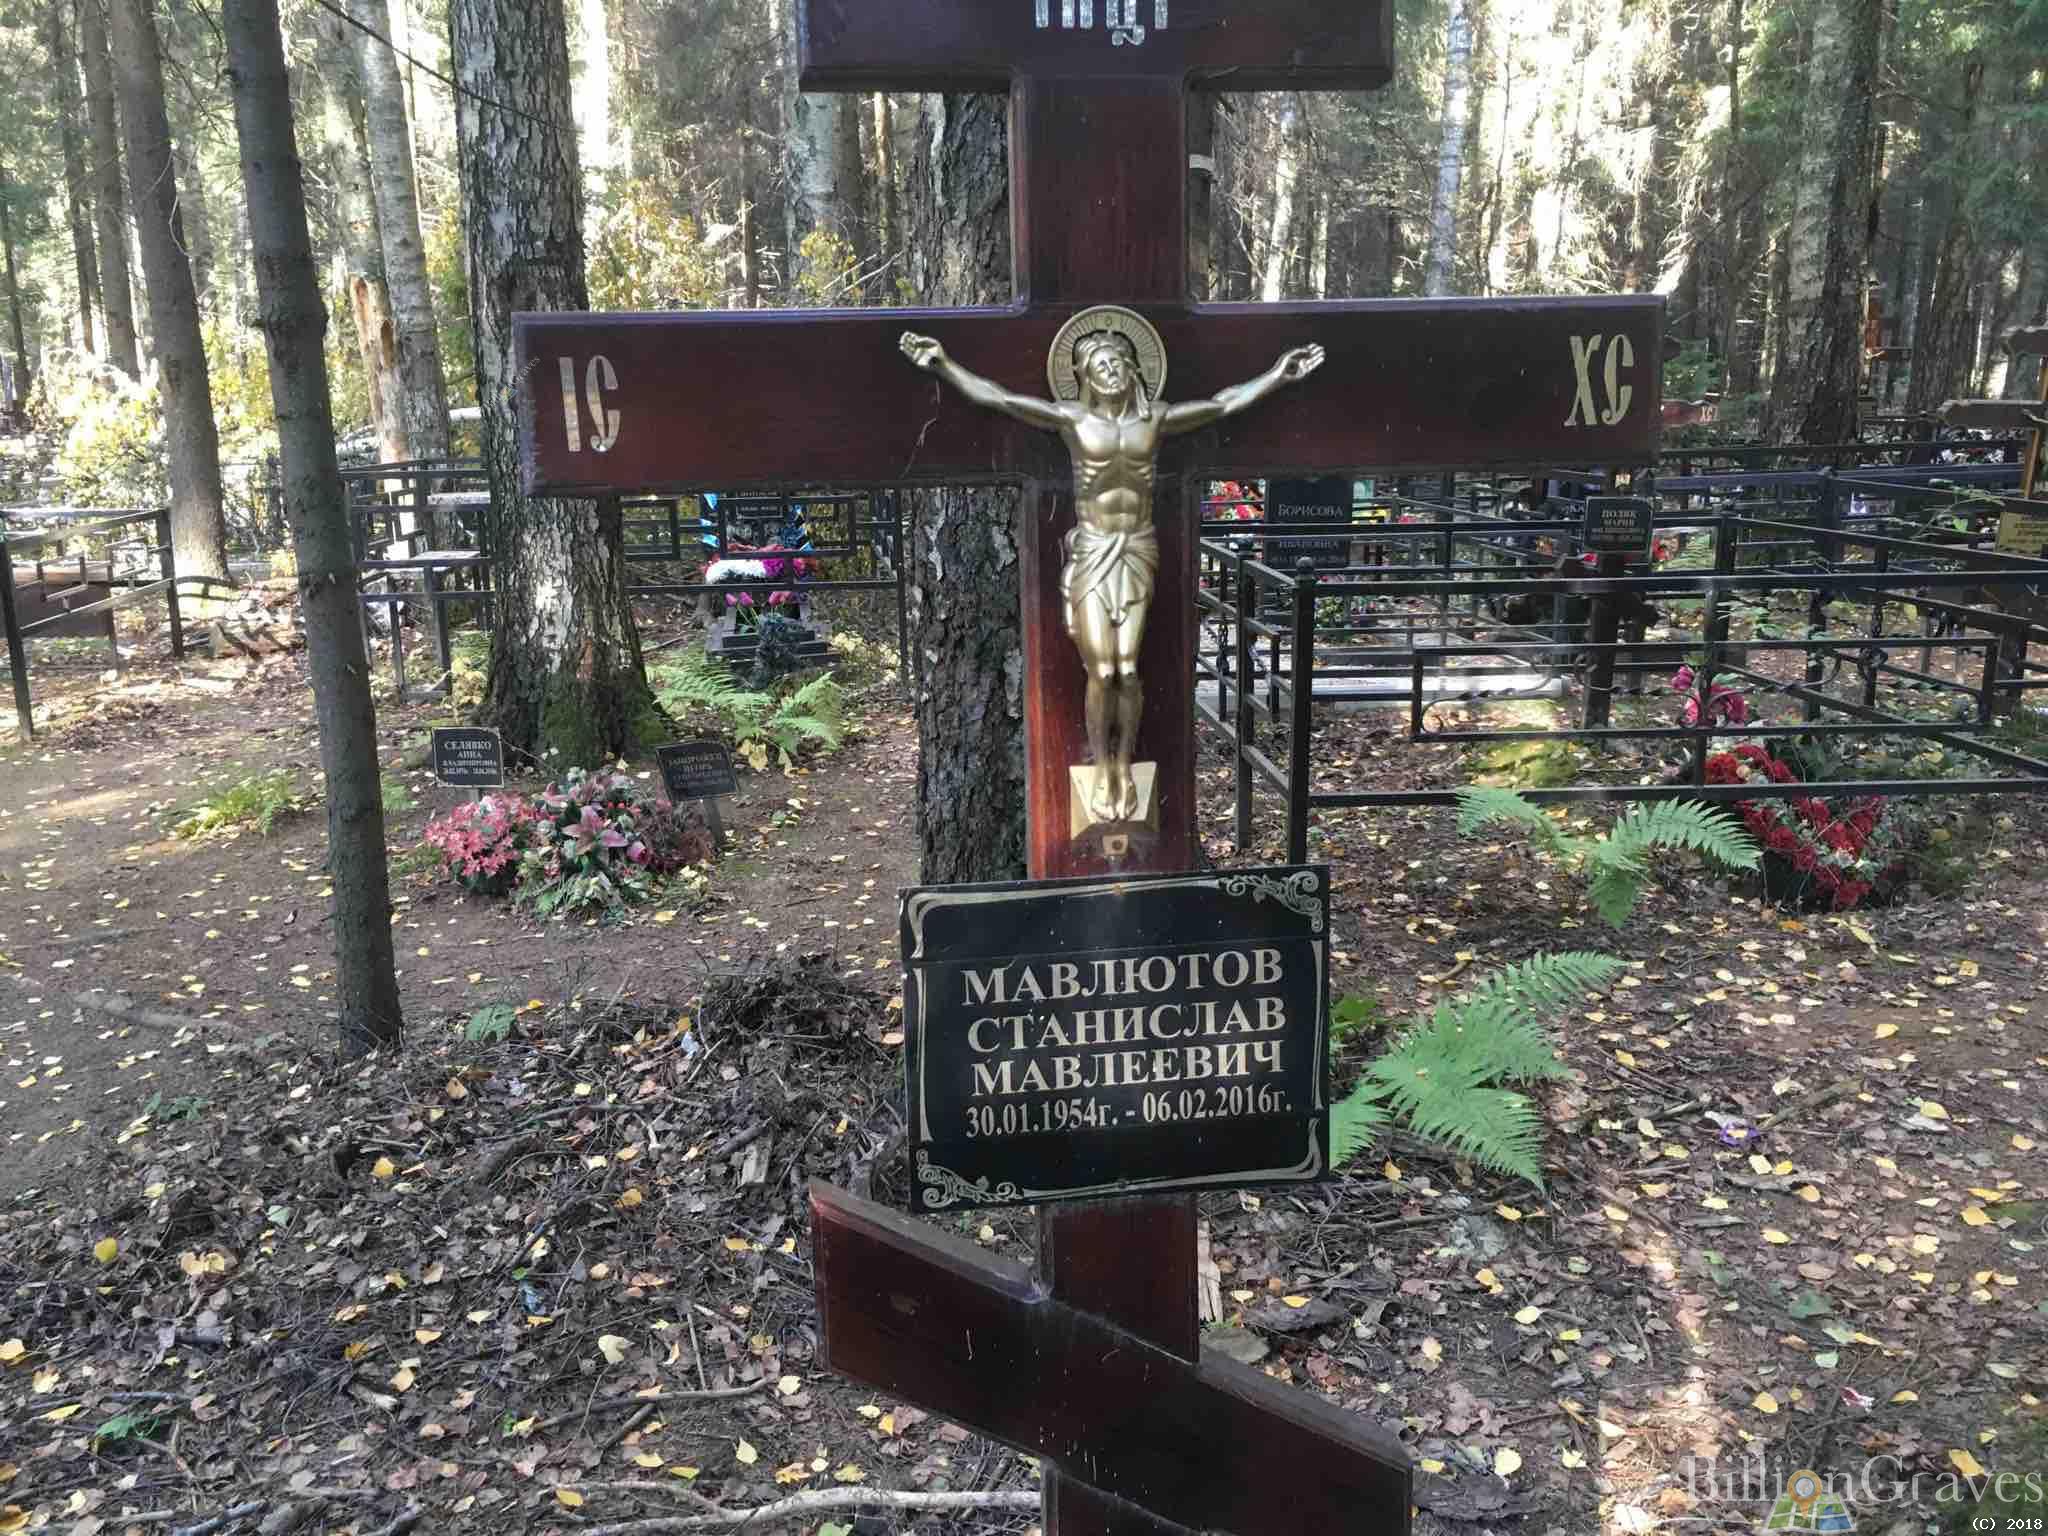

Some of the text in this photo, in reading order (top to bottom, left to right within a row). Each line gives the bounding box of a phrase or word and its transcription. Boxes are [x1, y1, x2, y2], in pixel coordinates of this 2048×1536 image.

[961, 948, 1284, 1006] МАВЛЮТОВ
[967, 997, 1287, 1053] СТАНИСЛАВ
[971, 1040, 1285, 1097] МАВЛЕЕВИЧ
[965, 1096, 1119, 1139] 30.01.1954г.
[1142, 1084, 1293, 1124] 06.02.2016г.
